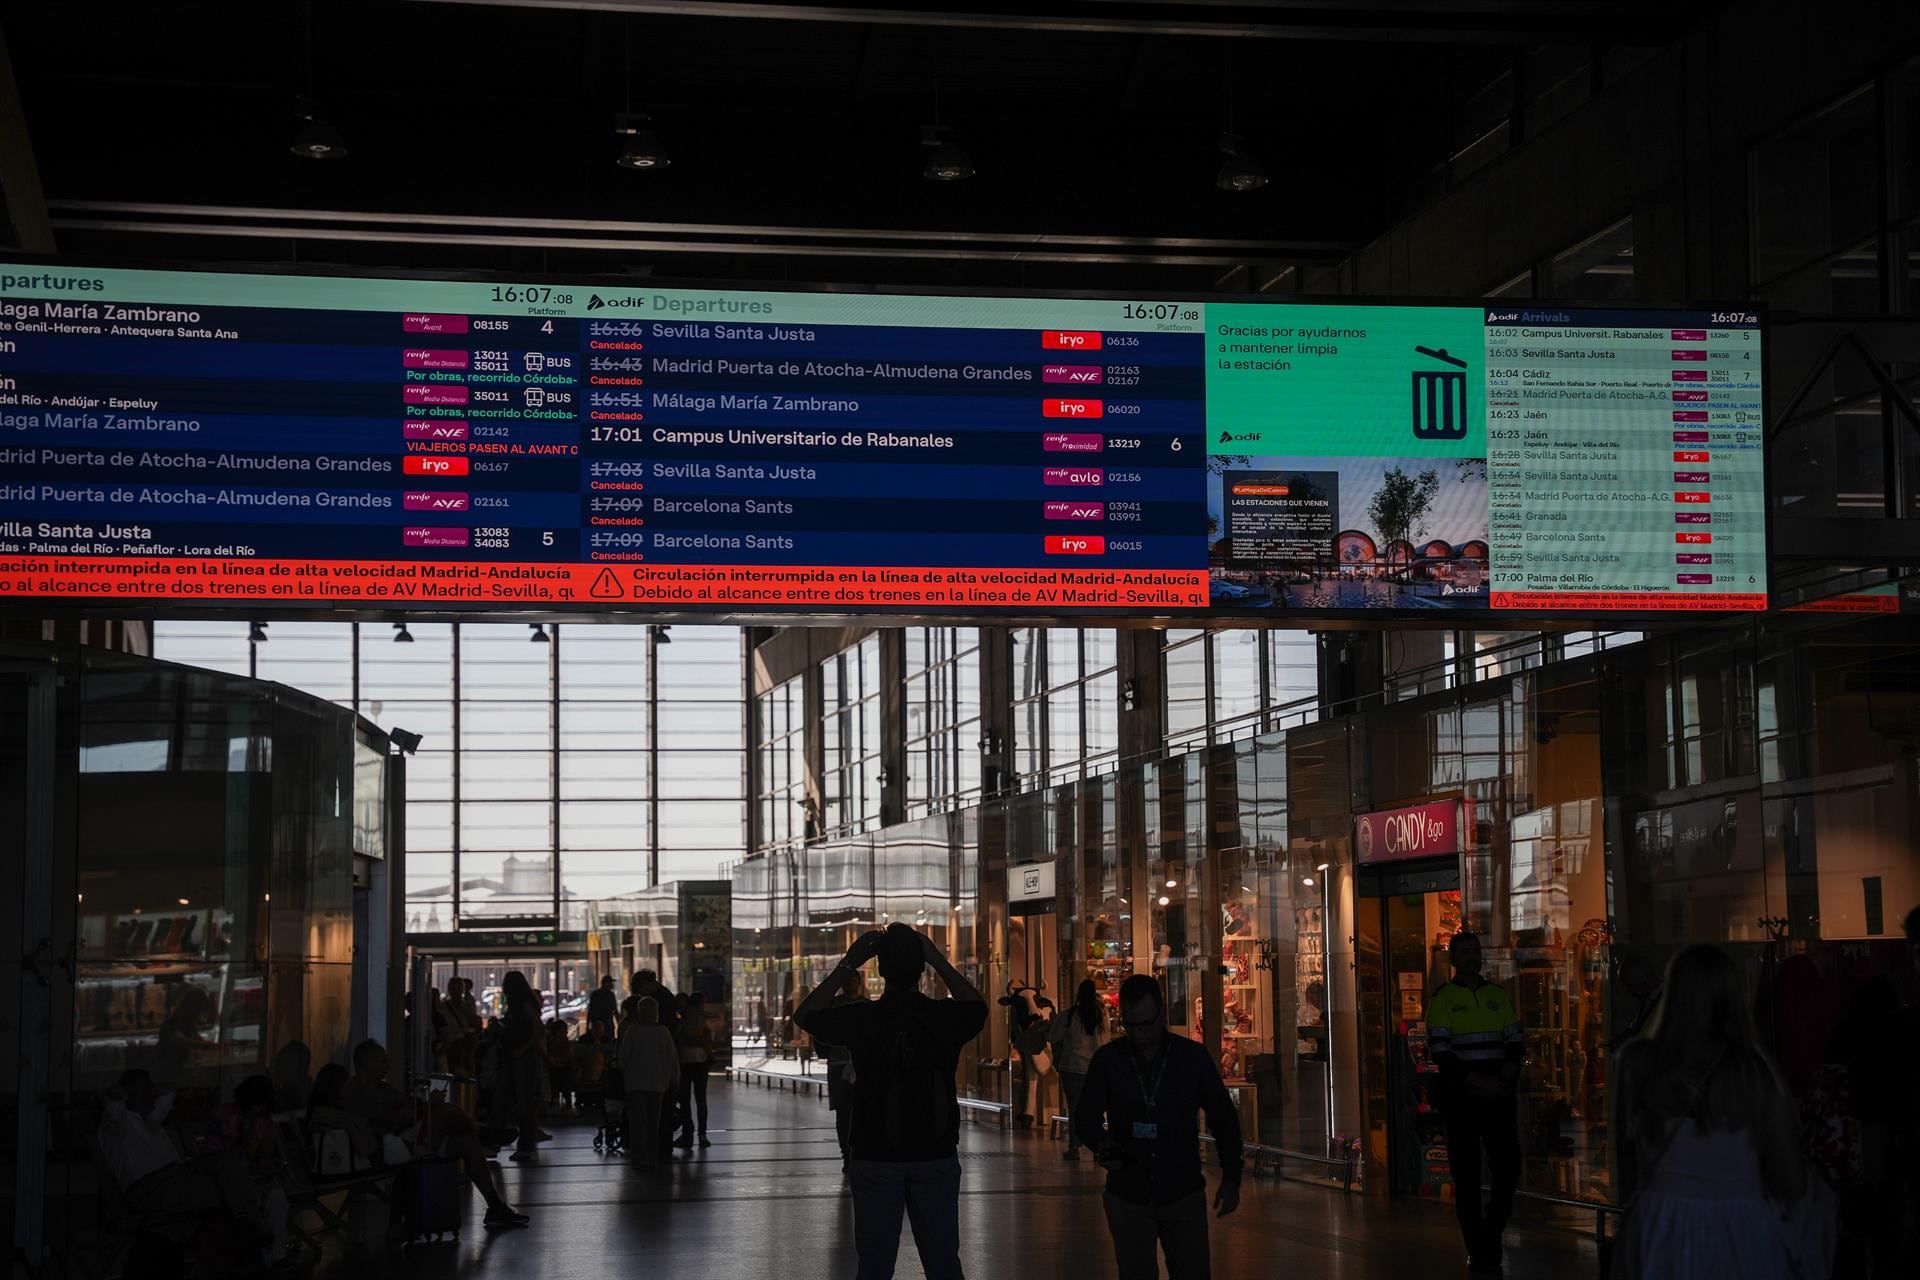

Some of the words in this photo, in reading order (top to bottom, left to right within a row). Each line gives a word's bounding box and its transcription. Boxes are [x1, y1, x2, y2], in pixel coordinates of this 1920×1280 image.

[2, 273, 104, 292] partures
[607, 297, 645, 308] adif
[653, 295, 773, 315] Departures
[45, 302, 98, 319] María
[104, 304, 200, 322] Zambrano
[528, 307, 567, 317] Platform
[1522, 312, 1570, 323] Arrivals
[15, 321, 101, 334] Genil-Herrera
[110, 326, 174, 338] Antequera
[177, 328, 211, 338] Santa
[215, 329, 238, 339] Ana
[473, 320, 509, 331] 08155
[541, 320, 554, 334] 4
[590, 321, 642, 337] 16:36
[1157, 323, 1193, 332] Platform
[652, 323, 710, 339] Sevilla
[714, 325, 764, 340] Santa
[768, 326, 815, 341] Justa
[1218, 324, 1268, 337] Gracias
[1272, 327, 1294, 340] por
[1298, 325, 1367, 340] ayudarnos
[1489, 328, 1518, 337] 16:02
[1522, 329, 1562, 339] Campus
[1564, 330, 1610, 339] Universit.
[1614, 330, 1664, 340] Rabanales
[590, 340, 643, 350] Cancelado
[1059, 333, 1084, 347] iryo
[1107, 337, 1139, 346] 06136
[1218, 344, 1226, 353] a
[1230, 342, 1294, 354] mantener
[1298, 341, 1337, 357] limpia
[1489, 349, 1518, 357] 16:03
[1522, 349, 1555, 358] Sevilla
[1557, 350, 1585, 358] Santa
[1588, 350, 1616, 359] Justa
[474, 350, 509, 361] 13011
[474, 361, 509, 371] 35011
[547, 357, 571, 368] BUS
[590, 357, 643, 372] 16:43
[1218, 358, 1231, 370] la
[1234, 358, 1291, 371] estación
[653, 358, 713, 374] Madrid
[718, 360, 774, 375] Puerta
[778, 361, 800, 376] de
[804, 362, 958, 380] Atocha-Almudena
[963, 365, 1032, 381] Grandes
[1107, 366, 1140, 375] 02163
[1490, 369, 1518, 378] 16:04
[1523, 369, 1551, 379] Cádiz
[406, 371, 427, 381] Por
[429, 371, 465, 383] obras,
[468, 372, 521, 383] recorrido
[523, 373, 577, 384] Córdoba-
[1107, 376, 1140, 386] 02167
[22, 394, 42, 405] Río
[51, 395, 99, 409] Andújar
[109, 398, 158, 410] Espeluy
[474, 392, 509, 402] 35011
[547, 393, 571, 403] BUS
[590, 392, 643, 407] 16:51
[653, 393, 716, 412] Málaga
[720, 393, 768, 410] María
[772, 396, 859, 412] Zambrano
[1060, 402, 1085, 415] iryo
[1108, 405, 1140, 415] 06020
[1490, 410, 1519, 419] 16:23
[1523, 410, 1547, 419] Jaén
[474, 427, 509, 437] 02142
[591, 427, 642, 442] 17:01
[1234, 432, 1262, 441] adif
[653, 429, 724, 446] Campus
[729, 429, 836, 446] Universitario
[841, 431, 863, 446] de
[867, 433, 954, 448] Rabanales
[1108, 439, 1140, 449] 13219
[1171, 438, 1181, 450] 6
[407, 441, 466, 453] VIAJEROS
[469, 443, 508, 454] PASEN
[510, 444, 526, 454] AL
[528, 445, 568, 456] AVANT
[42, 449, 104, 465] Puerta
[110, 452, 134, 466] de
[139, 452, 310, 470] Atocha-Almudena
[316, 456, 392, 472] Grandes
[422, 458, 449, 473] iryo
[474, 462, 509, 472] 06167
[590, 462, 643, 477] 17:03
[653, 463, 711, 479] Sevilla
[715, 464, 764, 480] Santa
[768, 466, 816, 481] Justa
[1070, 472, 1100, 485] avlo
[1108, 473, 1141, 483] 02156
[474, 498, 509, 507] 02161
[591, 497, 643, 512] 17:09
[653, 498, 740, 514] Barcelona
[745, 499, 793, 514] Sants
[1109, 502, 1141, 511] 03941
[1246, 499, 1288, 507] ESTACIONES
[1109, 512, 1141, 522] 03991
[38, 522, 93, 538] Santa
[99, 524, 152, 540] Justa
[474, 528, 509, 538] 13083
[474, 538, 509, 548] 34083
[542, 532, 554, 546] 5
[591, 532, 643, 547] 17:09
[653, 533, 740, 549] Barcelona
[745, 534, 794, 550] Sants
[1062, 538, 1087, 551] iryo
[29, 542, 68, 553] Palma
[70, 543, 90, 553] del
[94, 543, 113, 554] Río
[123, 544, 174, 555] Peñaflor
[184, 545, 211, 555] Lora
[214, 545, 234, 556] del
[236, 545, 255, 556] Río
[1109, 541, 1142, 551] 06015
[591, 551, 644, 561] Cancelado
[633, 568, 726, 581] Circulación
[730, 569, 835, 586] interrumpida
[838, 571, 858, 582] en
[862, 571, 877, 583] la
[881, 570, 919, 583] línea
[923, 571, 942, 584] de
[947, 571, 976, 584] alta
[980, 571, 1057, 585] velocidad
[1061, 572, 1200, 585] Madrid-Andalucía
[1494, 573, 1523, 582] 17:00
[1527, 573, 1557, 582] Palma
[1560, 573, 1575, 582] del
[1578, 574, 1593, 582] Río
[1455, 585, 1480, 595] adif
[1385, 811, 1426, 853] CANDY
[1428, 819, 1443, 841] &go
